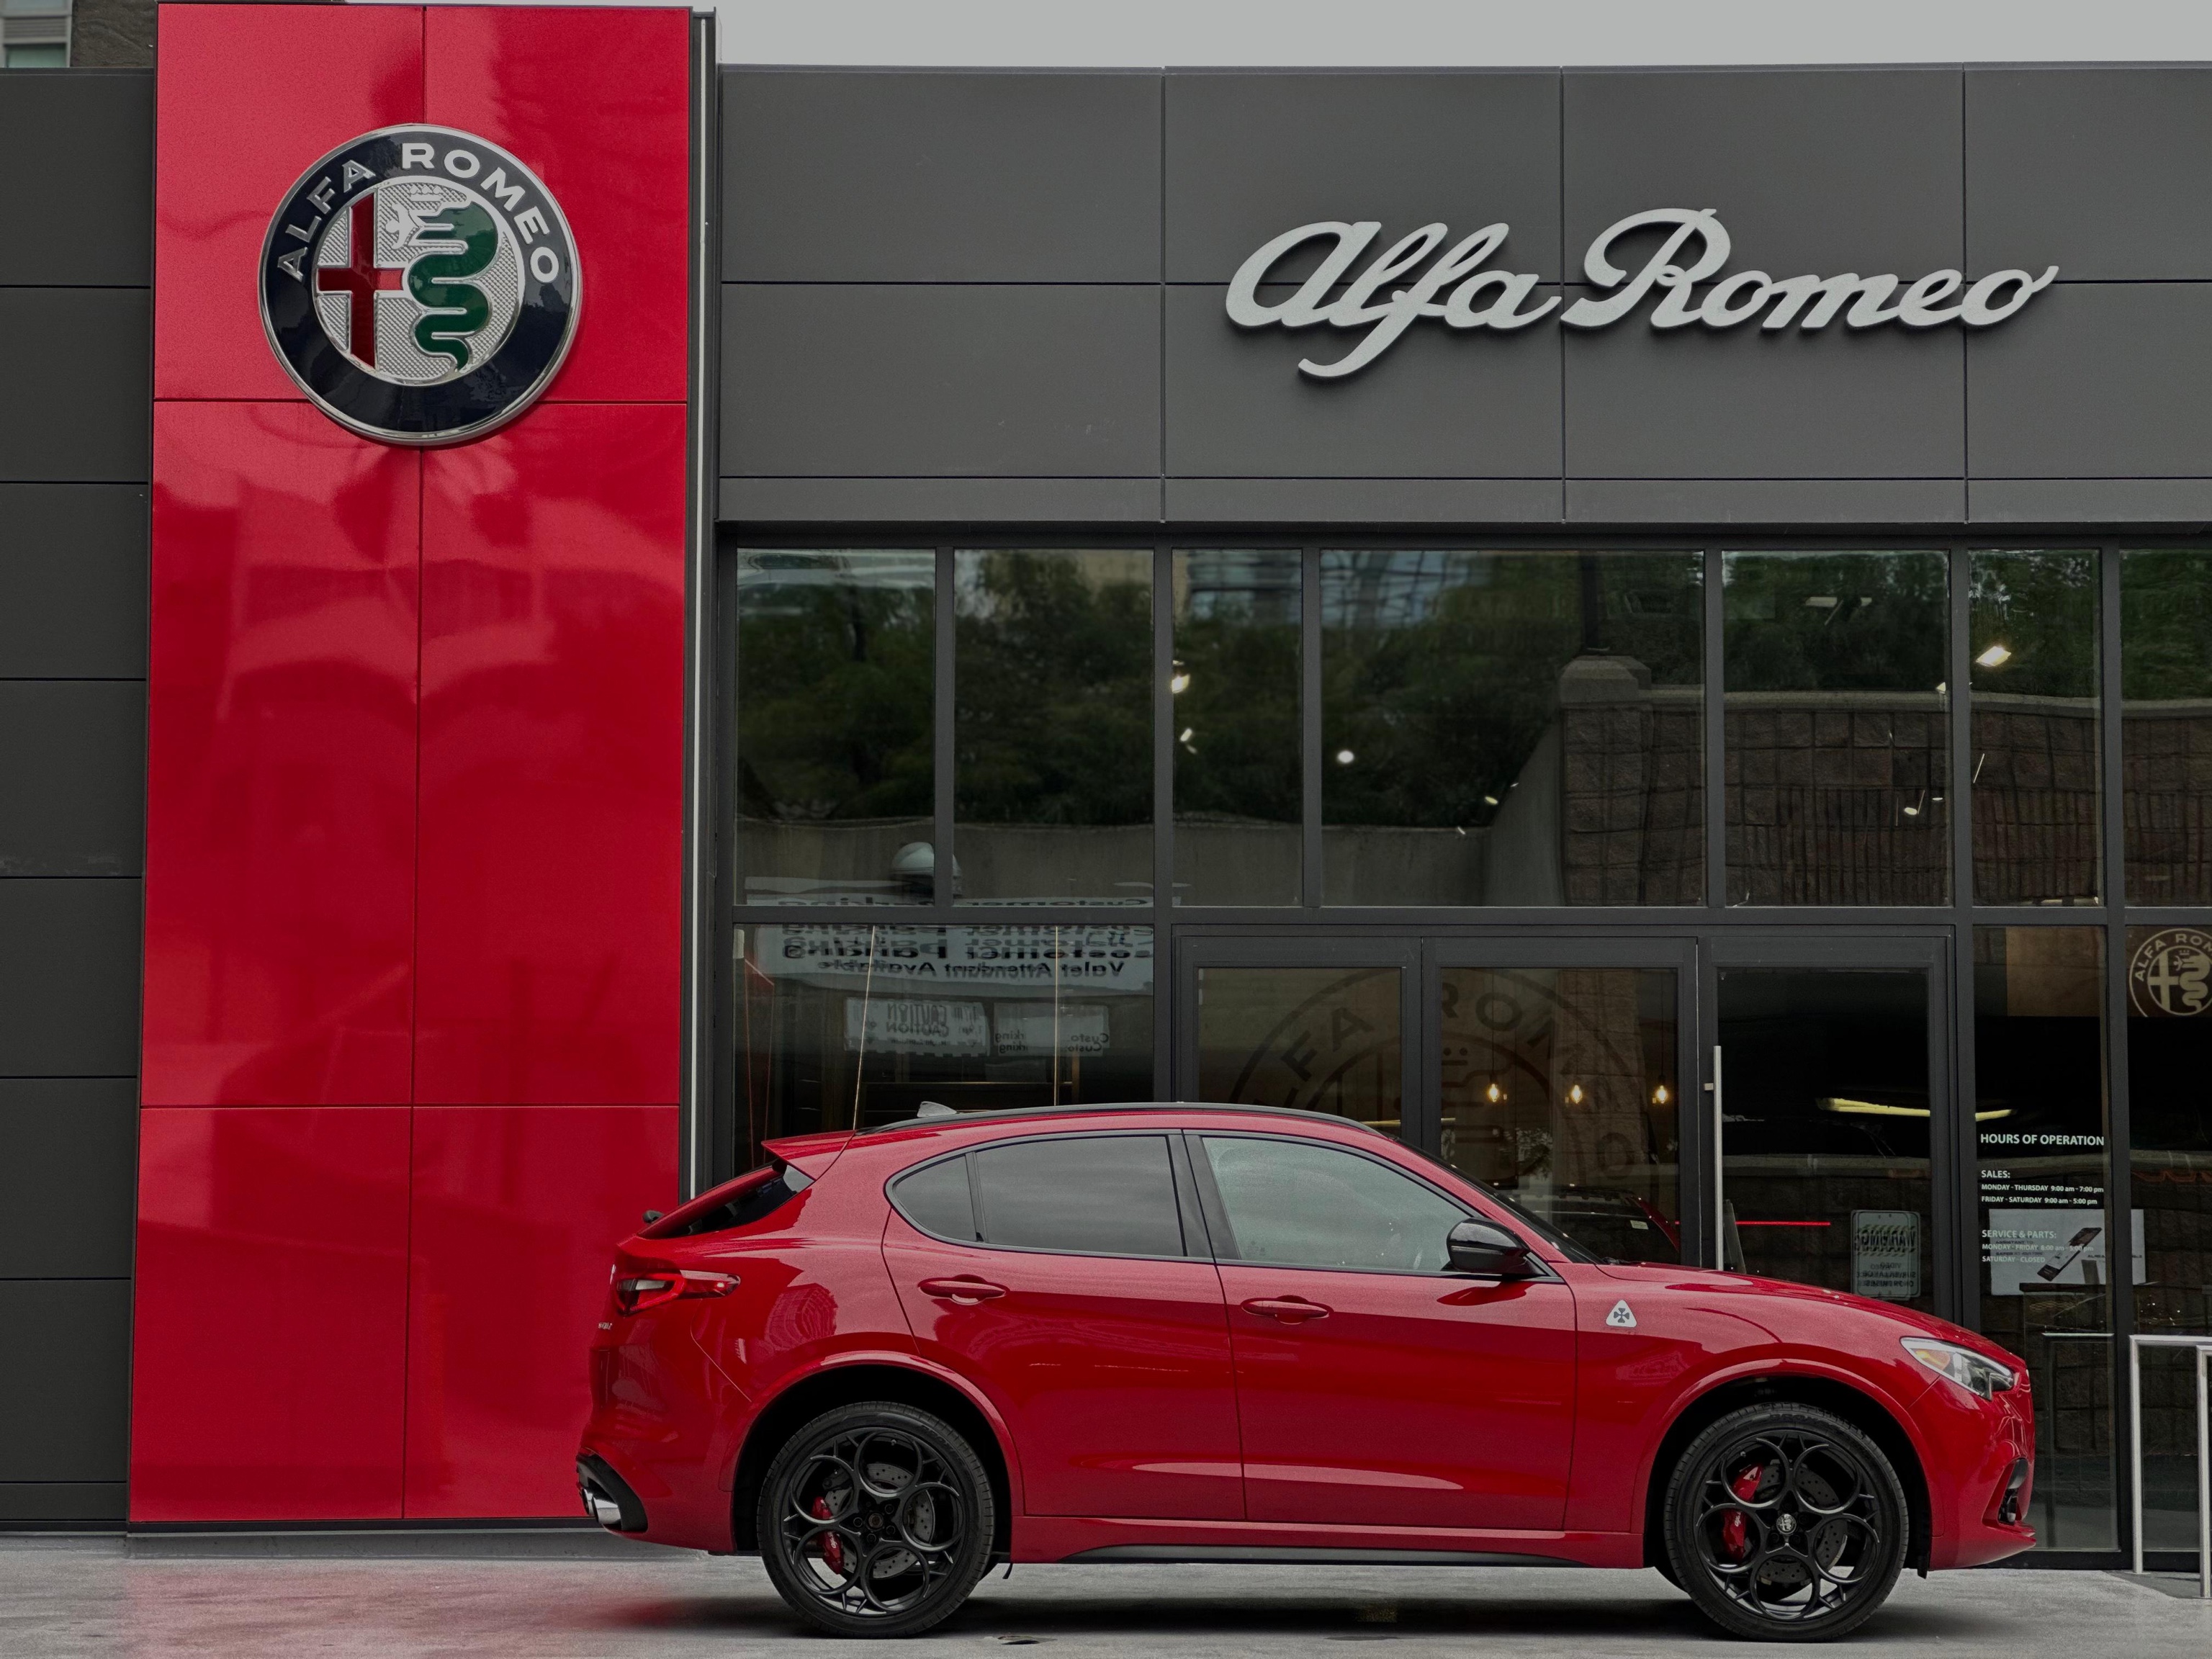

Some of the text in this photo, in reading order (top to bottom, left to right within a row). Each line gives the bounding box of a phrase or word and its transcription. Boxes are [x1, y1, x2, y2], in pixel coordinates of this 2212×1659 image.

[277, 143, 559, 283] ALFA ROMEO
[1226, 207, 2059, 377] Alfa Romeo
[2135, 939, 2167, 982] ALFA
[1980, 1133, 2105, 1146] HOURS OF OPERATION
[1981, 1170, 2010, 1179] SALES:
[1982, 1229, 2018, 1238] SERVICE
[2019, 1230, 2026, 1238] &
